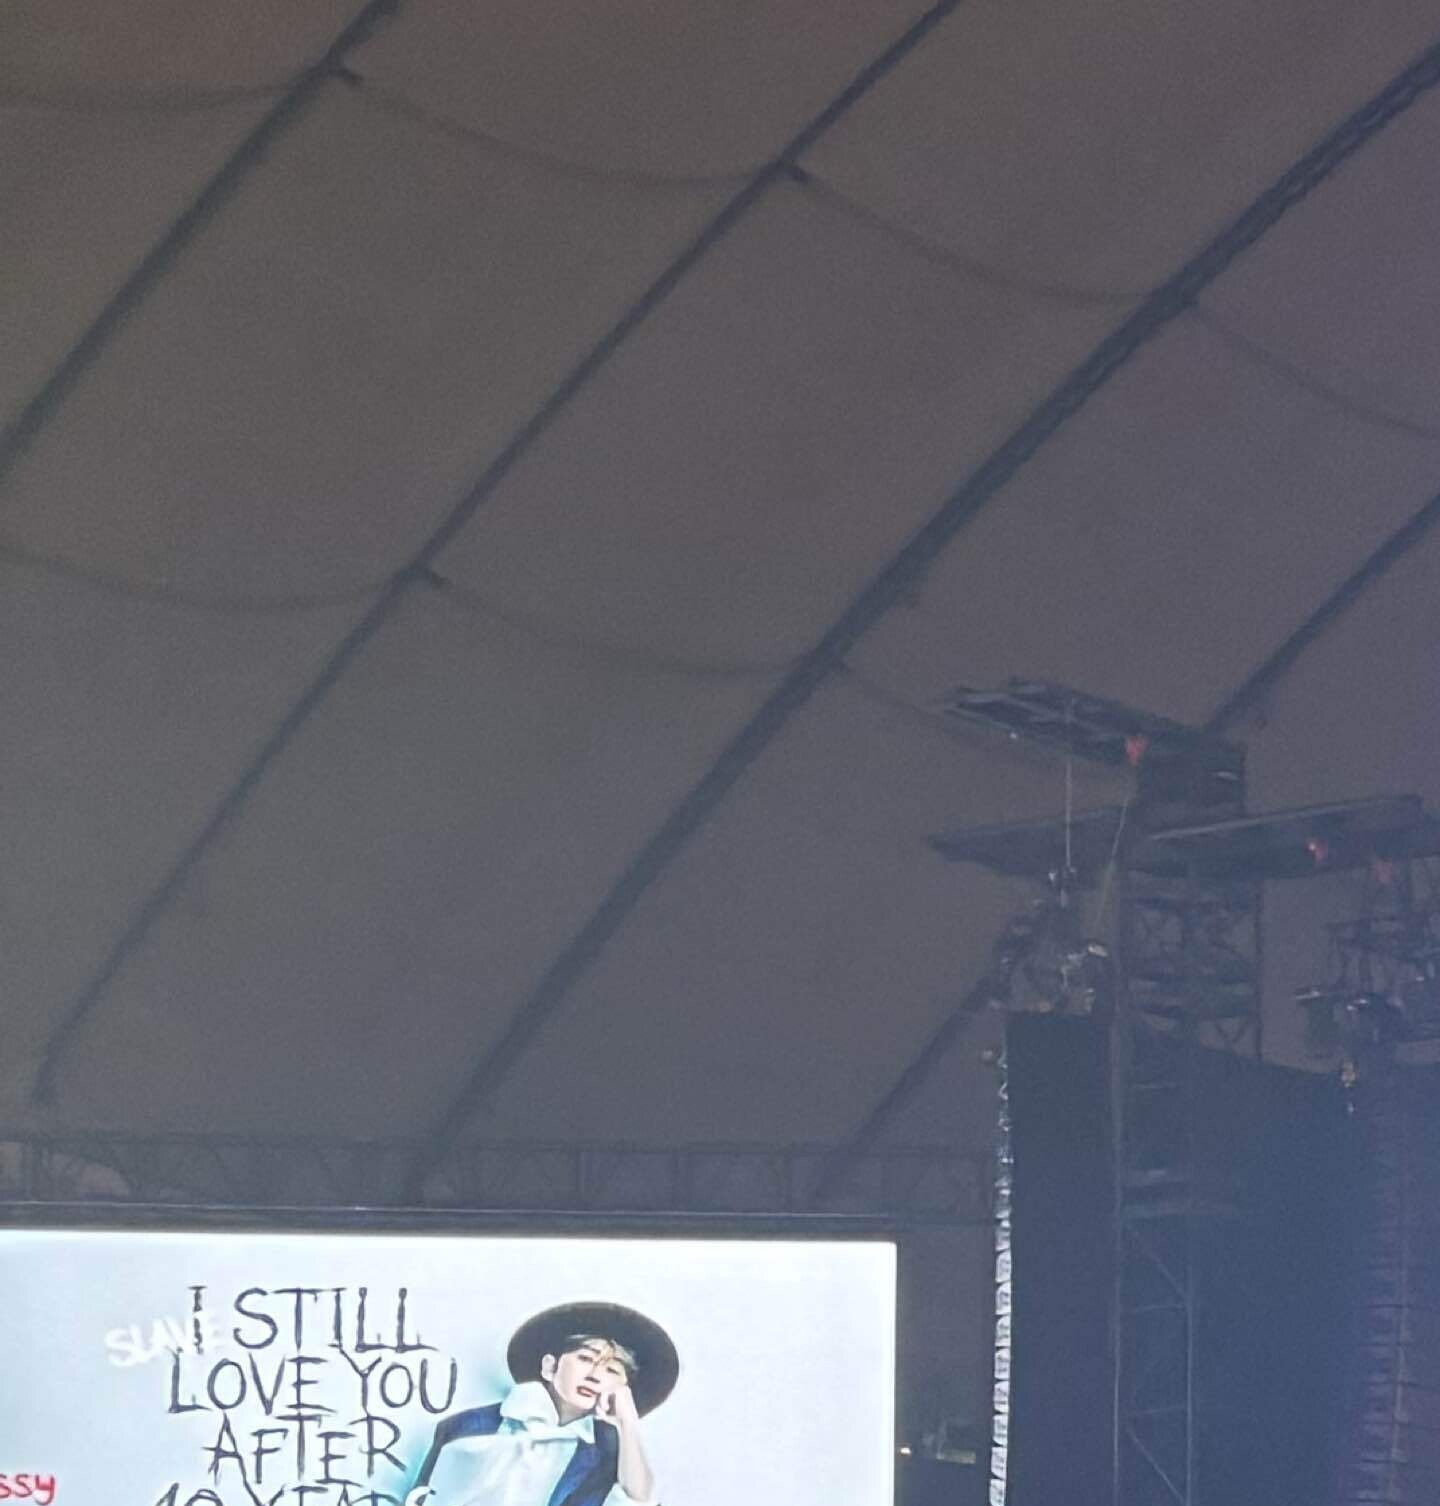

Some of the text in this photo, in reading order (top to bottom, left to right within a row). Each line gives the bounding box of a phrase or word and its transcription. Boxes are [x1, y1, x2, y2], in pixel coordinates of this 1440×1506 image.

[187, 1284, 438, 1354] I STILL
[168, 1348, 457, 1416] LOVE YOU
[202, 1412, 406, 1486] AFTER
